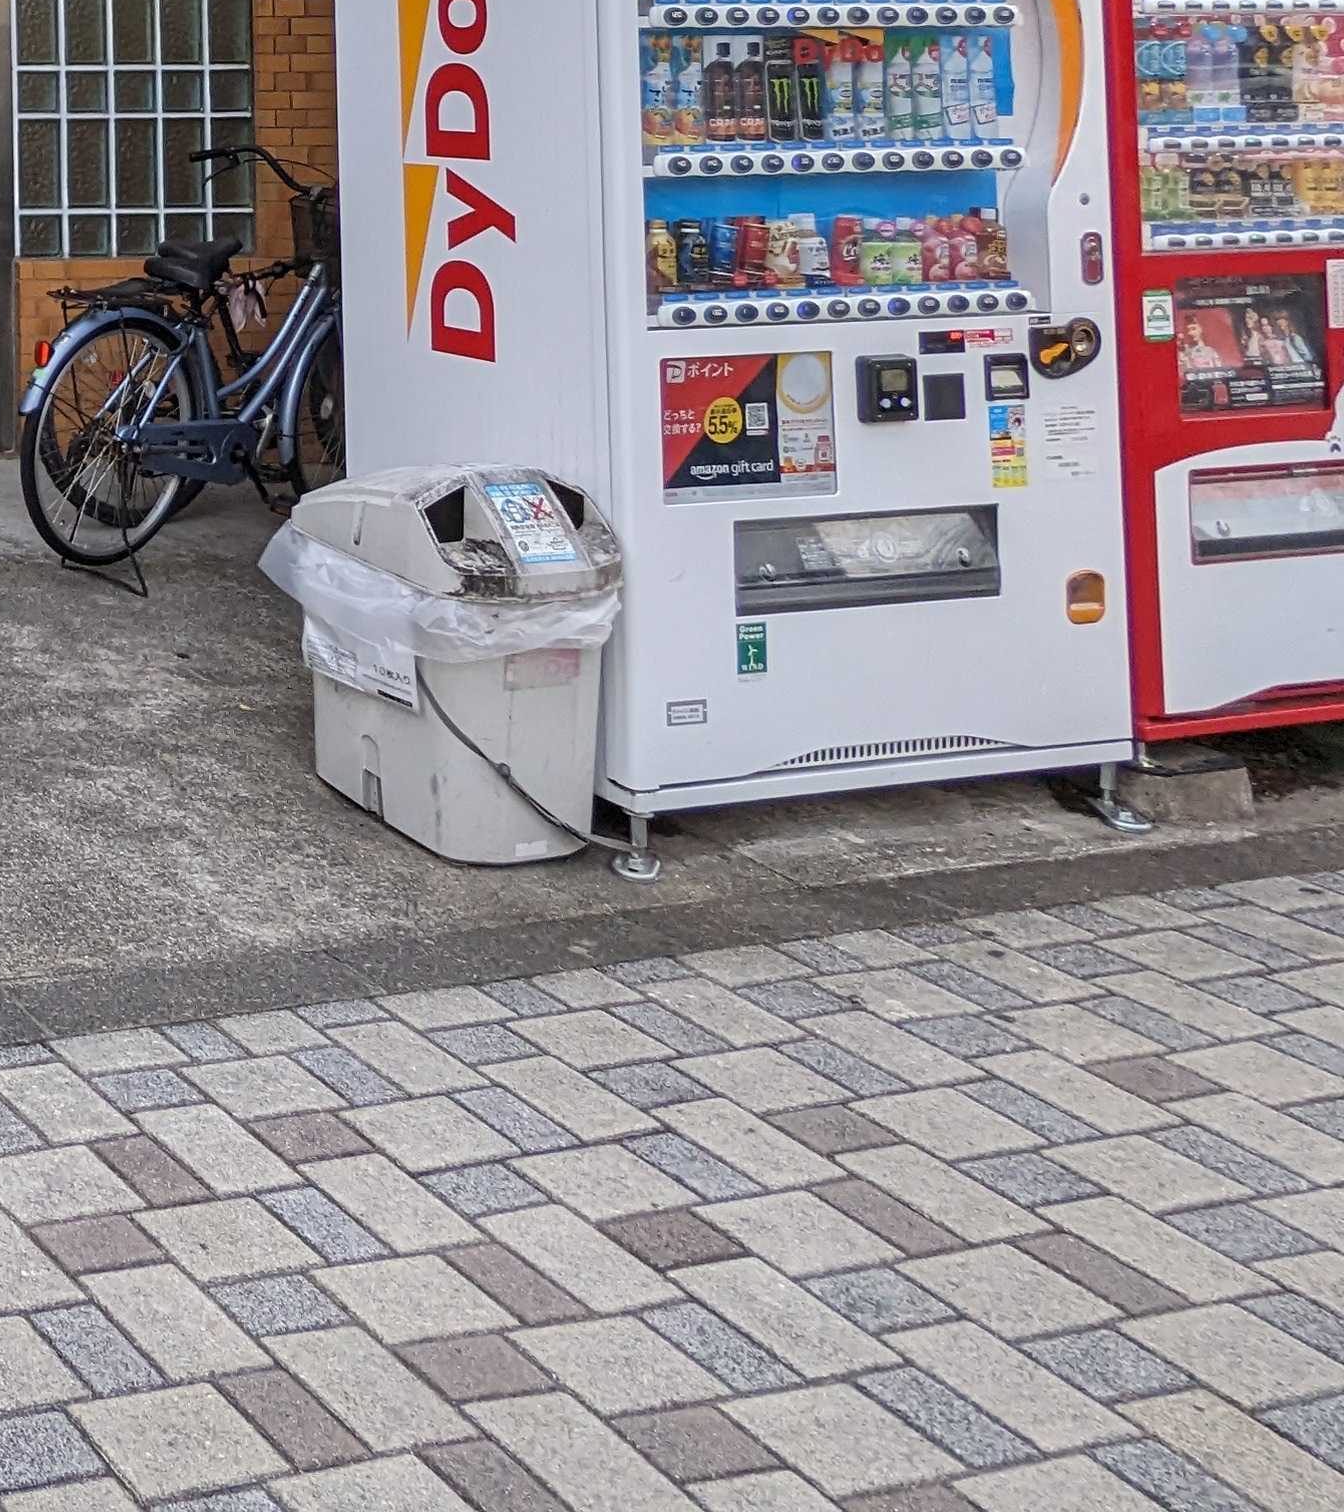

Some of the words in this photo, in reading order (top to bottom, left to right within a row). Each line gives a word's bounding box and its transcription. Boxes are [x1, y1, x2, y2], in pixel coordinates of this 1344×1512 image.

[687, 362, 734, 379] ポイント
[690, 463, 730, 479] amazon
[730, 460, 751, 477] gift
[751, 459, 774, 473] card
